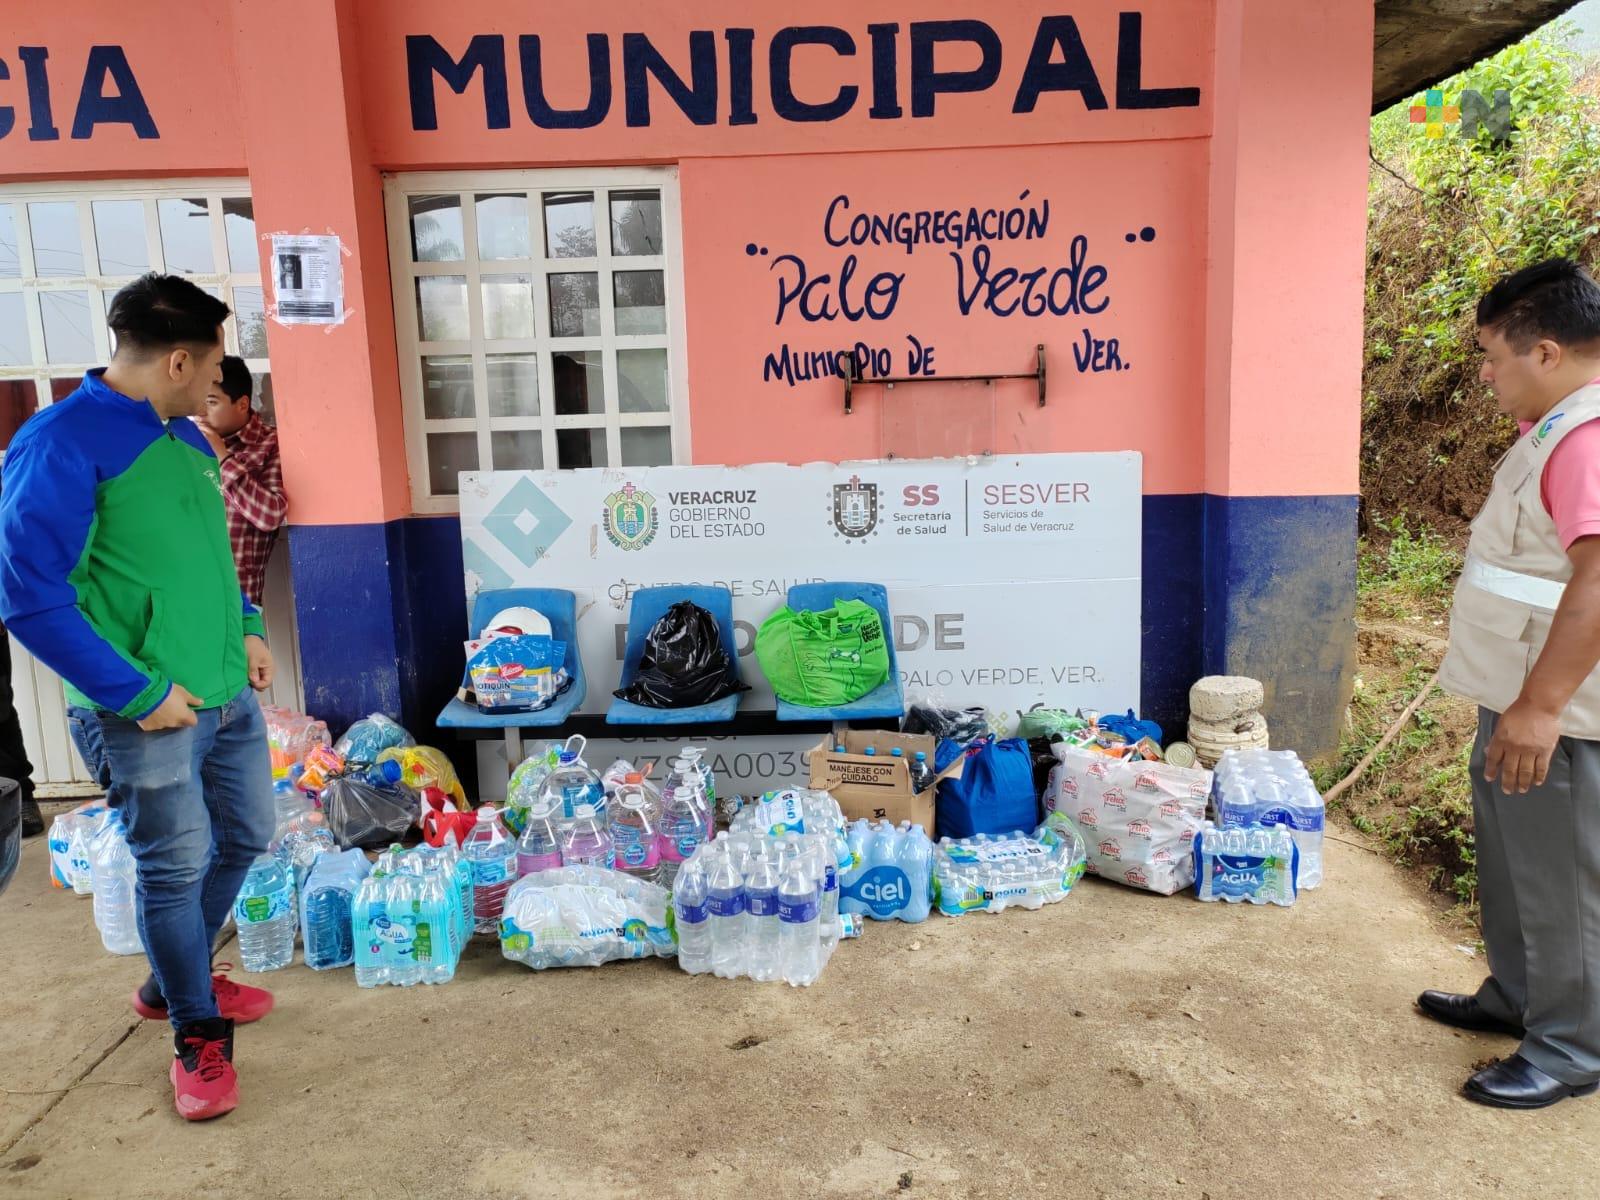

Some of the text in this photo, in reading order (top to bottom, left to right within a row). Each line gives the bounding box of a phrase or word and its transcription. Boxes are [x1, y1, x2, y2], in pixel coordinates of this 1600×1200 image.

[404, 11, 1200, 131] MUNICIPAL
[0, 45, 160, 141] IA
[824, 189, 1049, 254] CONGREGACIÓN
[769, 235, 1110, 326] Palo Verde
[906, 334, 936, 377] DE
[1072, 328, 1130, 374] VER.
[668, 490, 757, 506] VERACRUZ
[903, 484, 940, 507] SS
[983, 482, 1091, 506] SESVER
[669, 506, 751, 522] GOBIERNO
[983, 509, 1043, 520] Servicios de
[670, 522, 765, 539] DEL ESTADO
[896, 524, 948, 535] de Salud
[983, 521, 1075, 533] Salud de Veracruz
[841, 773, 879, 783] CUIDADO
[873, 767, 892, 776] CON
[1220, 872, 1259, 885] AGUA
[860, 875, 904, 902] ciel
